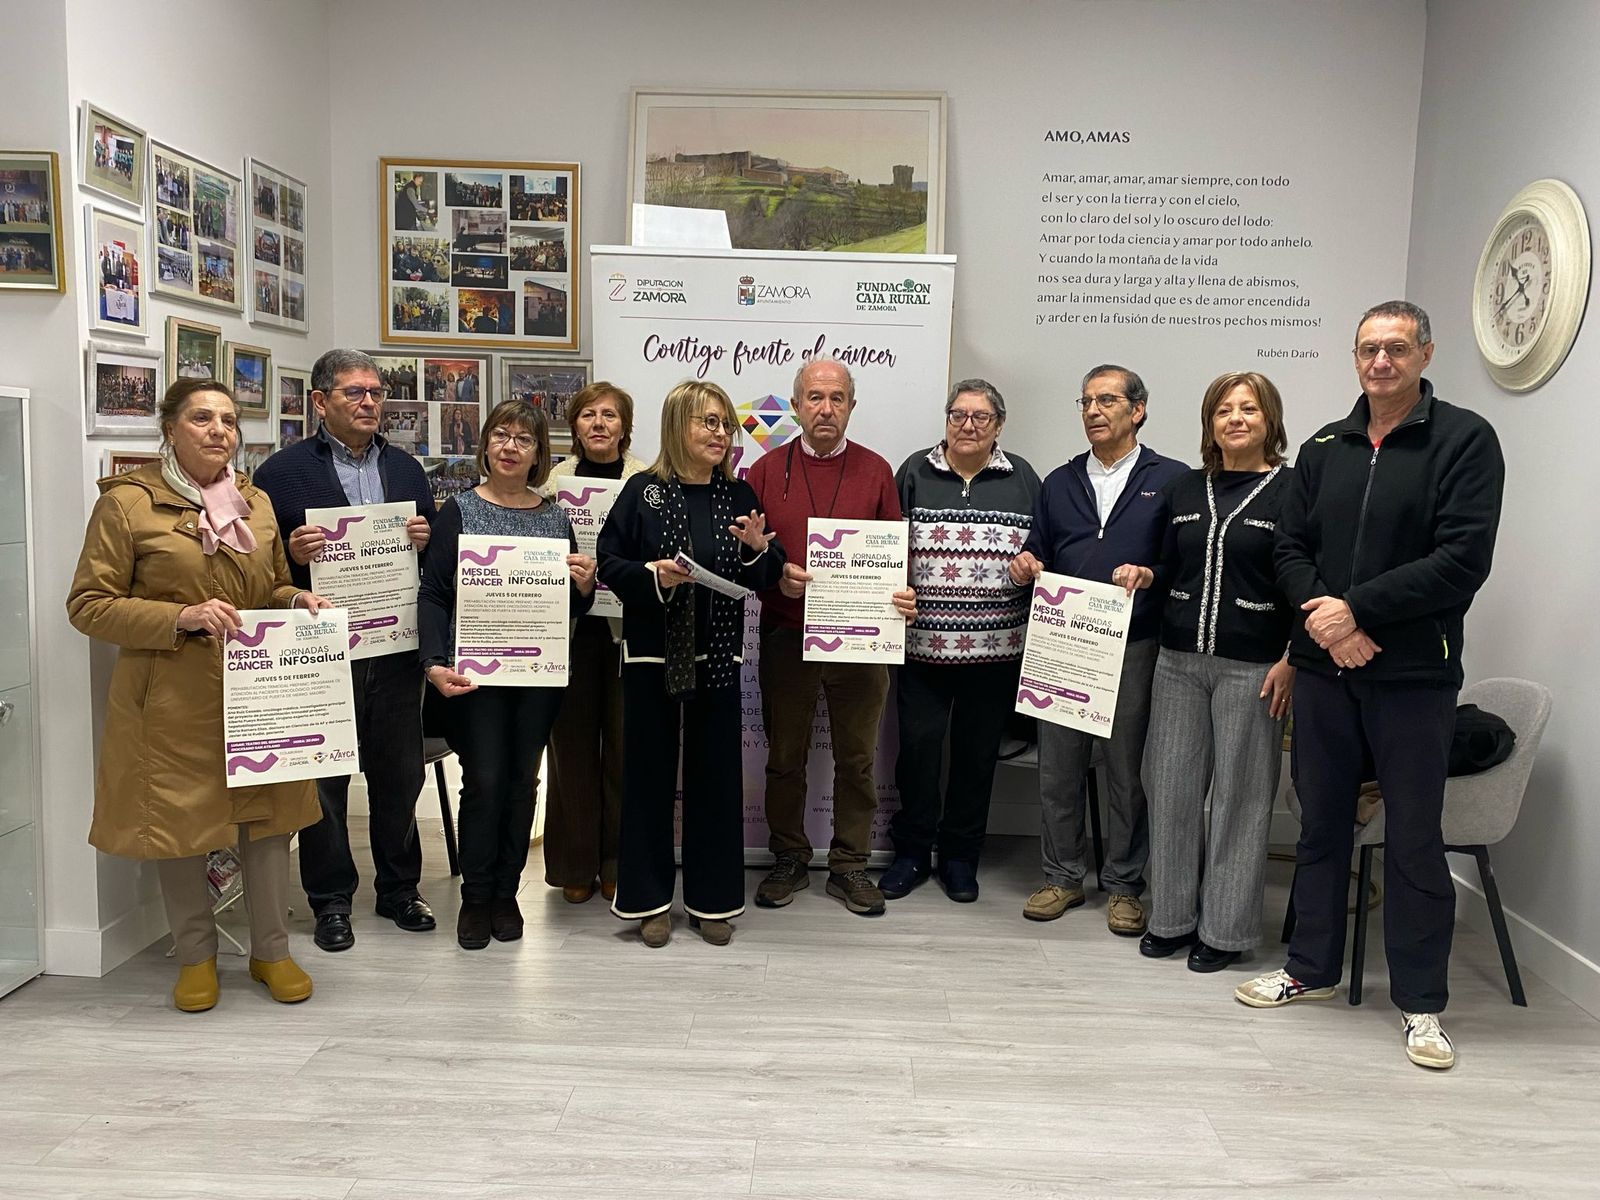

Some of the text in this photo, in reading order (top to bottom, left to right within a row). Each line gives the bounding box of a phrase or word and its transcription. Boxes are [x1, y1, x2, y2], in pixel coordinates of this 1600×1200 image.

[1044, 130, 1130, 145] AMO, AMAS
[1042, 172, 1290, 187] Amar, amar, amar, amar siempre, con todo
[1041, 191, 1240, 208] el ser y con la tierra y con el cielo,
[1040, 212, 1273, 228] con lo claro del sol y lo oscuro del lodo:
[1039, 233, 1313, 249] Amar por toda ciencia y amar por todo anhelo.
[1521, 230, 1532, 253] 12
[1038, 252, 1218, 266] Y cuando la montaña de la vida
[1038, 272, 1299, 289] nos sea dura y larga y alta y llena de abismos,
[633, 292, 687, 304] ZAMORA
[757, 285, 812, 298] ZAMORA
[1496, 283, 1504, 305] 9
[856, 293, 930, 304] CAJA RURAL
[1037, 292, 1310, 307] amar la inmensidad que es de amor encendida
[1036, 312, 1321, 328] ¡y arder en la fusión de nuestros pechos mismos!
[1515, 323, 1524, 345] 6
[643, 334, 726, 378] Contigo
[733, 339, 794, 376] frente
[832, 344, 896, 368] cáncer
[1257, 348, 1319, 359] Rubén Darío
[577, 509, 592, 517] DEL
[335, 542, 352, 550] DEL
[360, 538, 400, 548] JORNADAS
[360, 543, 412, 557] INFOsalud
[810, 551, 844, 559] MES DEL
[313, 552, 355, 563] CÁNCER
[810, 558, 846, 568] CÁNCER
[851, 560, 903, 569] INFOsalud
[462, 568, 500, 576] MES DEL
[508, 569, 552, 577] JORNADAS
[462, 575, 503, 586] CÁNCER
[508, 577, 565, 585] INFOsalud
[1034, 604, 1065, 618] MES DEL
[1032, 612, 1066, 628] CÁNCER
[1072, 613, 1112, 627] JORNADAS
[296, 628, 337, 638] CAJA RURAL
[1071, 620, 1123, 639] INFOsalud
[1049, 631, 1066, 640] JUEVES
[1077, 638, 1098, 646] FEBRERO
[278, 645, 329, 657] JORNADAS
[882, 642, 902, 651] AZAYCA
[228, 648, 269, 660] MES DEL
[279, 651, 345, 666] INFOsalud
[227, 657, 273, 671] CÁNCER
[544, 662, 566, 672] AZAYCA
[293, 672, 319, 680] FEBRERO
[1090, 711, 1111, 724] AZAYCA
[329, 750, 355, 761] AZAYCA
